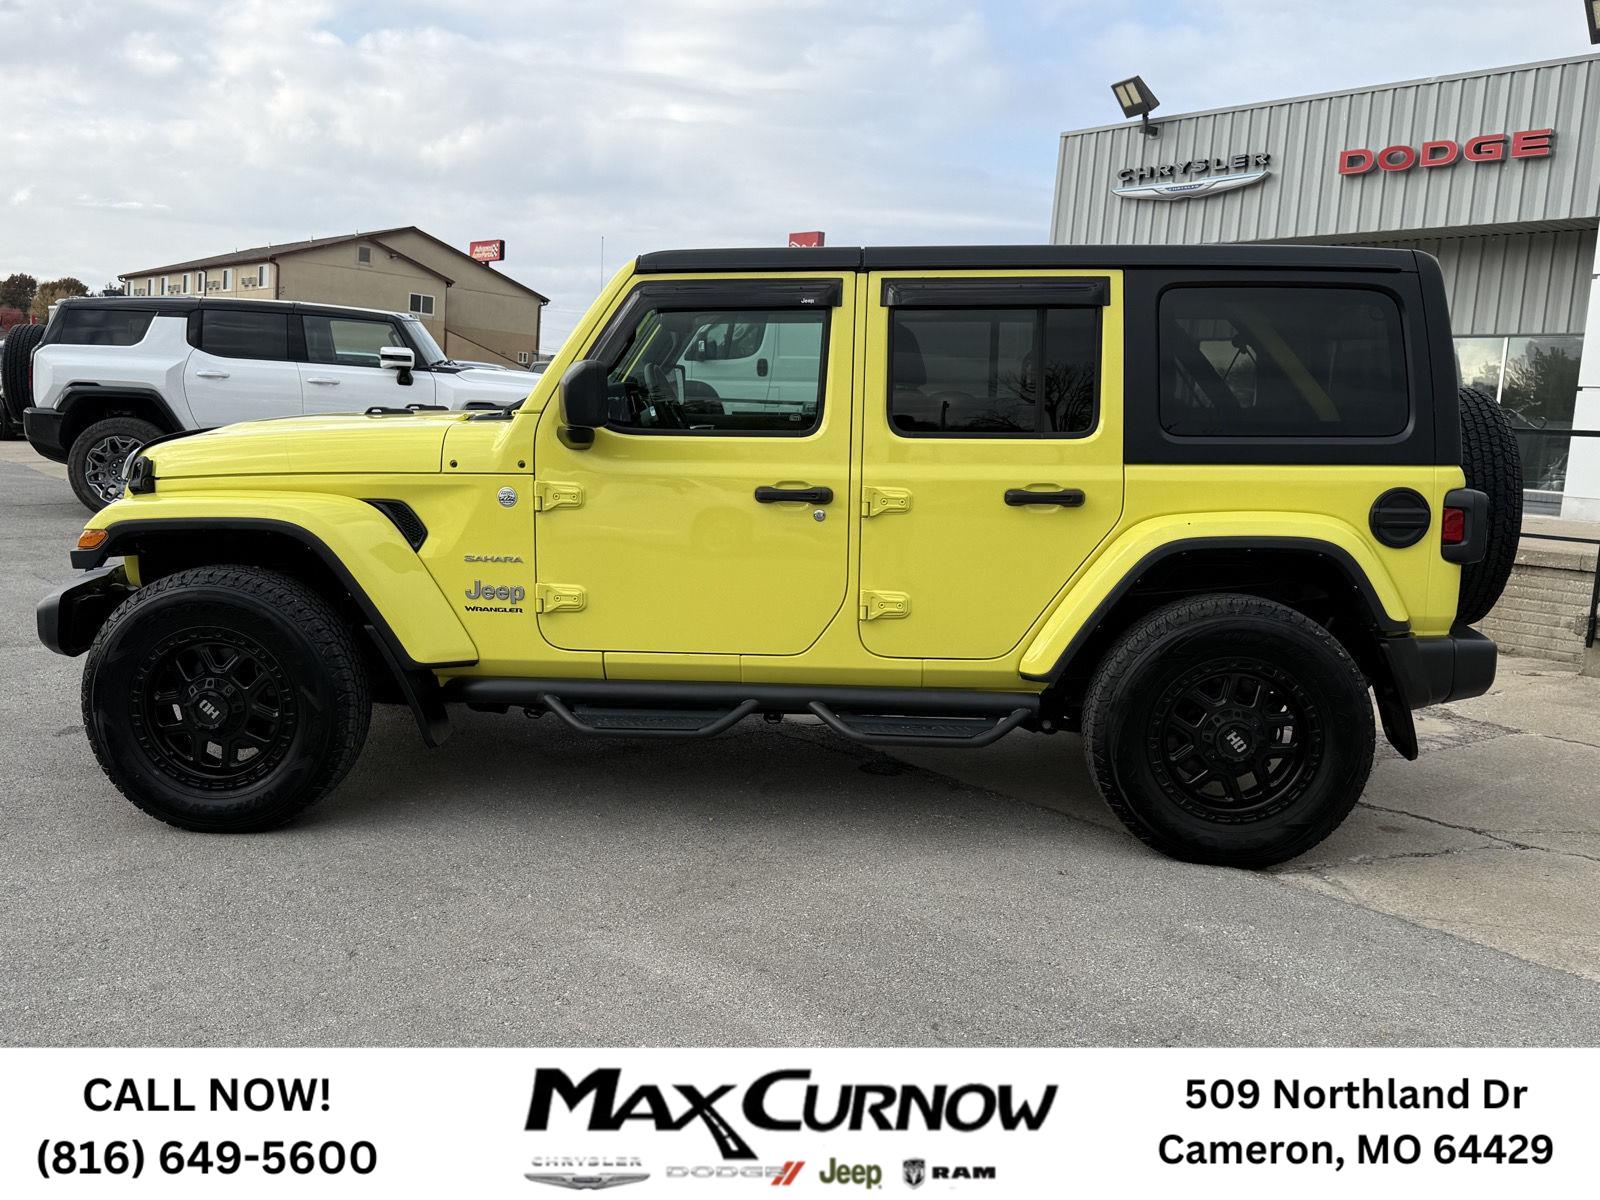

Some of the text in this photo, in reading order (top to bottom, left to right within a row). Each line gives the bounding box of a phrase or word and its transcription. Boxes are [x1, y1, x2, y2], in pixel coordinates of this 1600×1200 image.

[1338, 128, 1555, 175] DODGE
[1116, 152, 1271, 182] CHRYSLER
[464, 555, 524, 563] SAHARA
[465, 580, 525, 604] Jeep
[464, 605, 523, 613] WRANGLER
